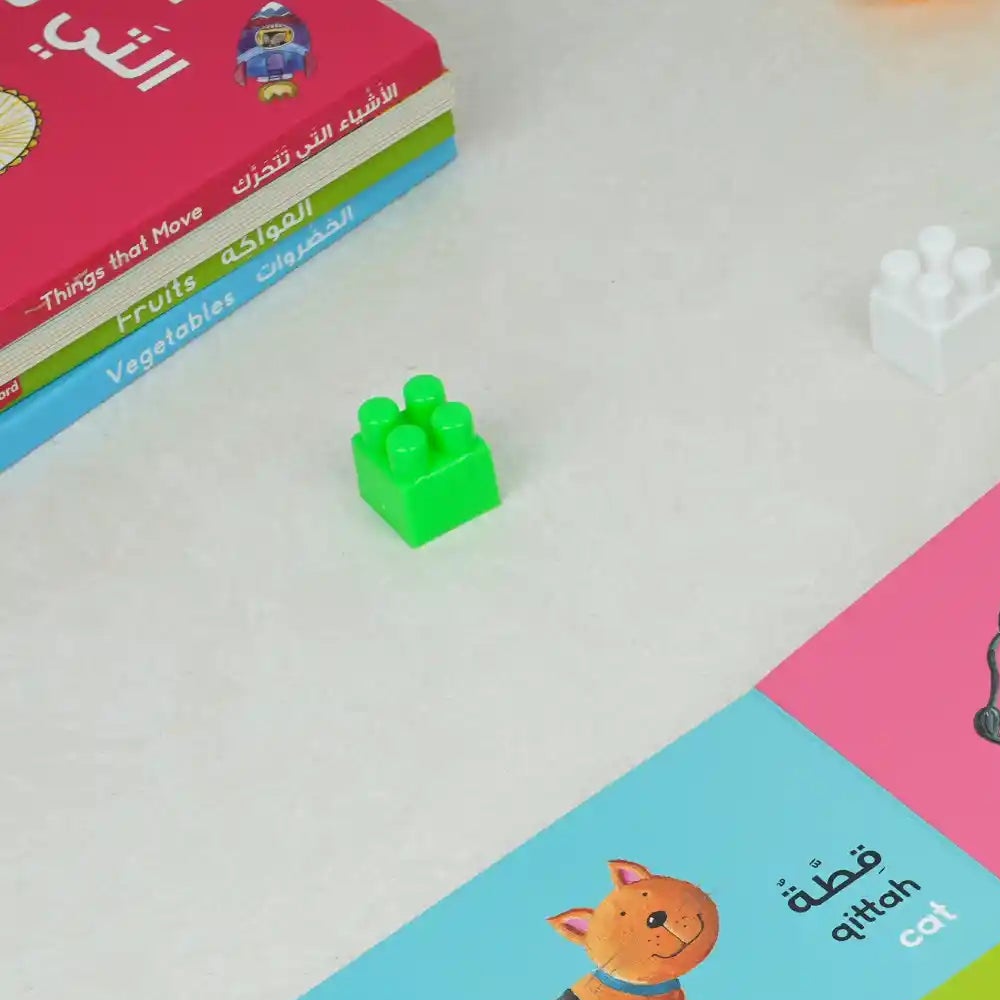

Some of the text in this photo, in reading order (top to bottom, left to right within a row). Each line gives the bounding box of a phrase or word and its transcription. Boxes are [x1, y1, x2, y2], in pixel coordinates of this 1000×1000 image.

[40, 206, 203, 311] Things that Move
[115, 275, 197, 333] Fruits
[106, 291, 235, 384] Vegetables
[831, 879, 921, 942] qittah
[899, 900, 958, 948] cat
